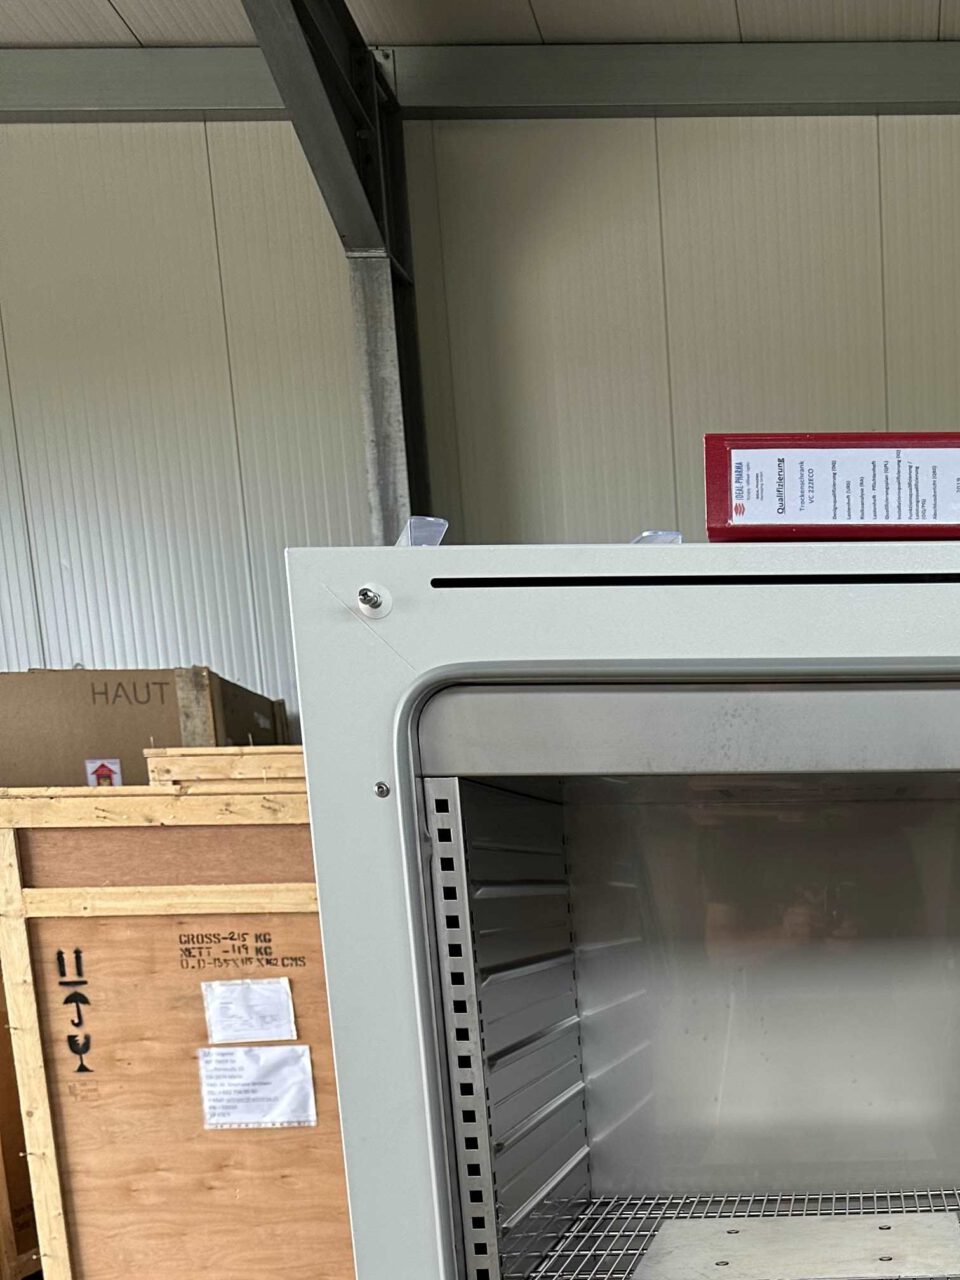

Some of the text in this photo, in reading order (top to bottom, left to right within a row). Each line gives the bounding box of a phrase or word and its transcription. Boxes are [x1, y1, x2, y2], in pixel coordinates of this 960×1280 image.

[735, 462, 744, 500] IDEAL-PHARMA
[777, 458, 785, 515] Qualifizierung
[809, 496, 815, 504] VC
[91, 682, 170, 705] HAUT
[254, 932, 273, 944] KG
[255, 946, 273, 957] KG
[281, 956, 306, 968] CMS
